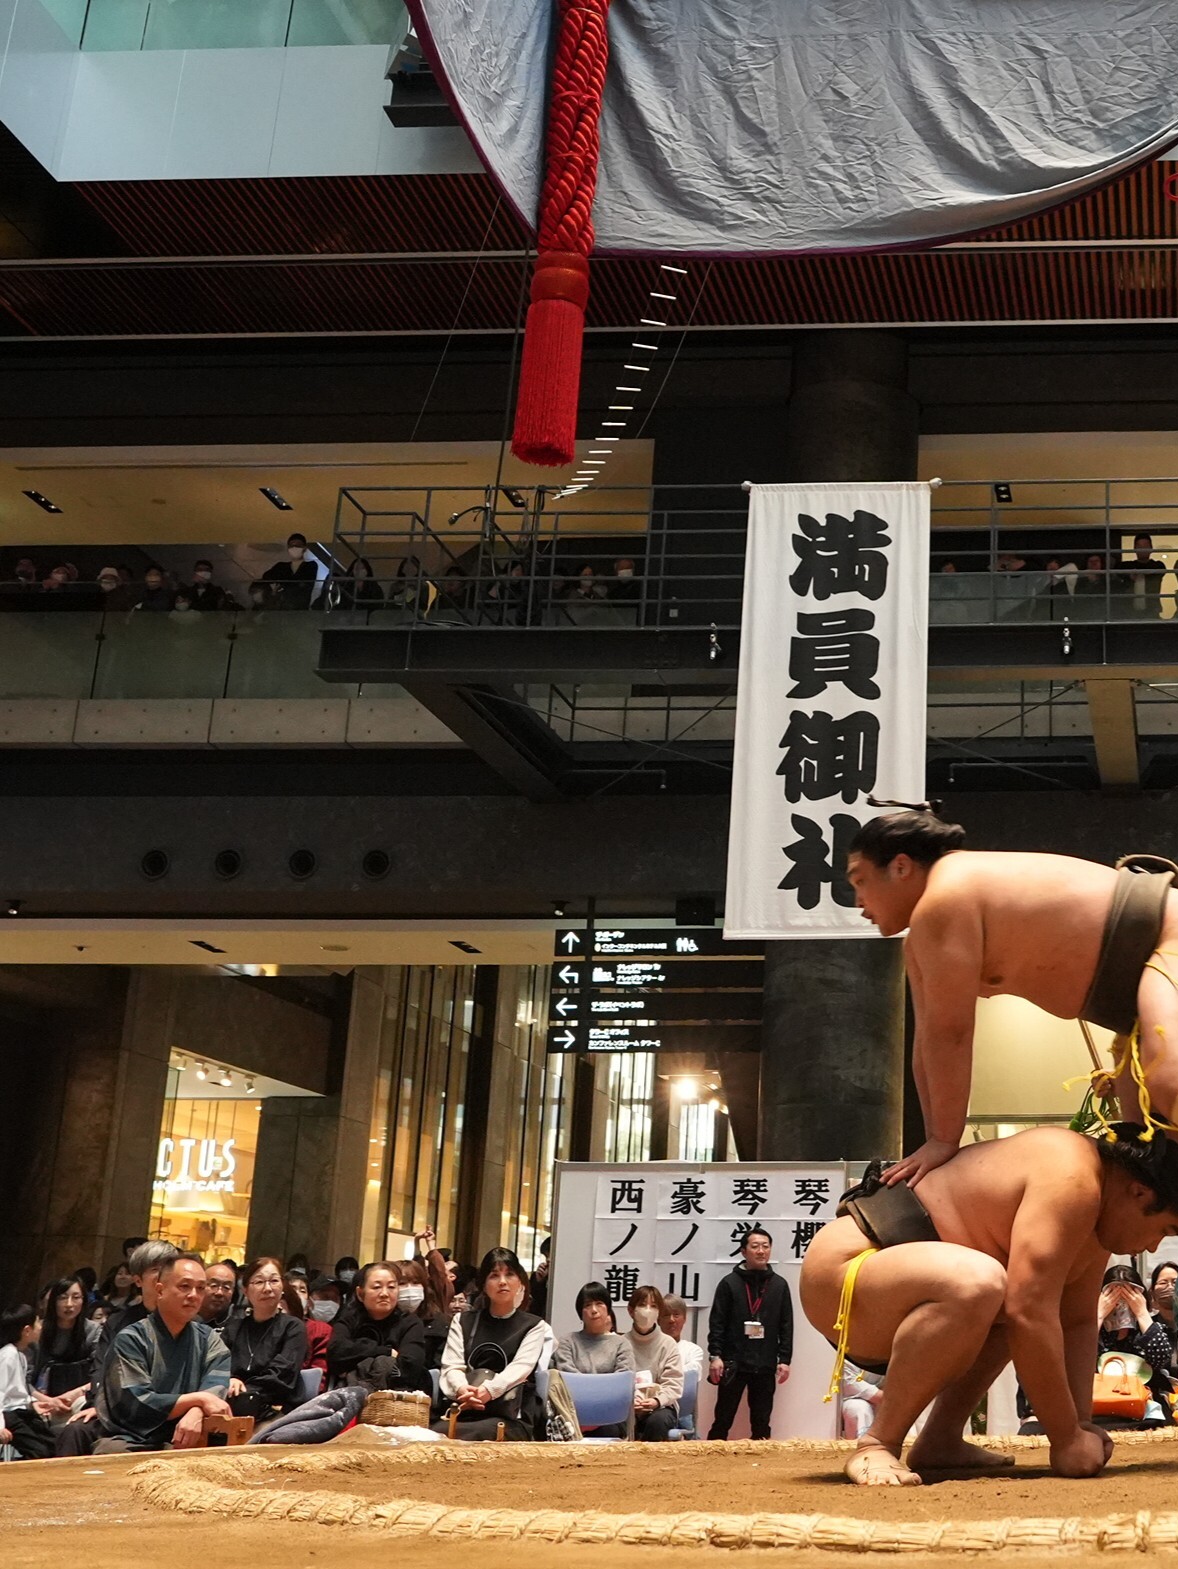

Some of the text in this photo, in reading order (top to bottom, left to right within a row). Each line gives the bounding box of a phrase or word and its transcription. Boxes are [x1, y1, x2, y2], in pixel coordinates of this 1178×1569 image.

[776, 509, 892, 910] 満員御礼
[604, 1178, 645, 1302] 西ノ龍
[669, 1177, 706, 1302] 豪ノ山
